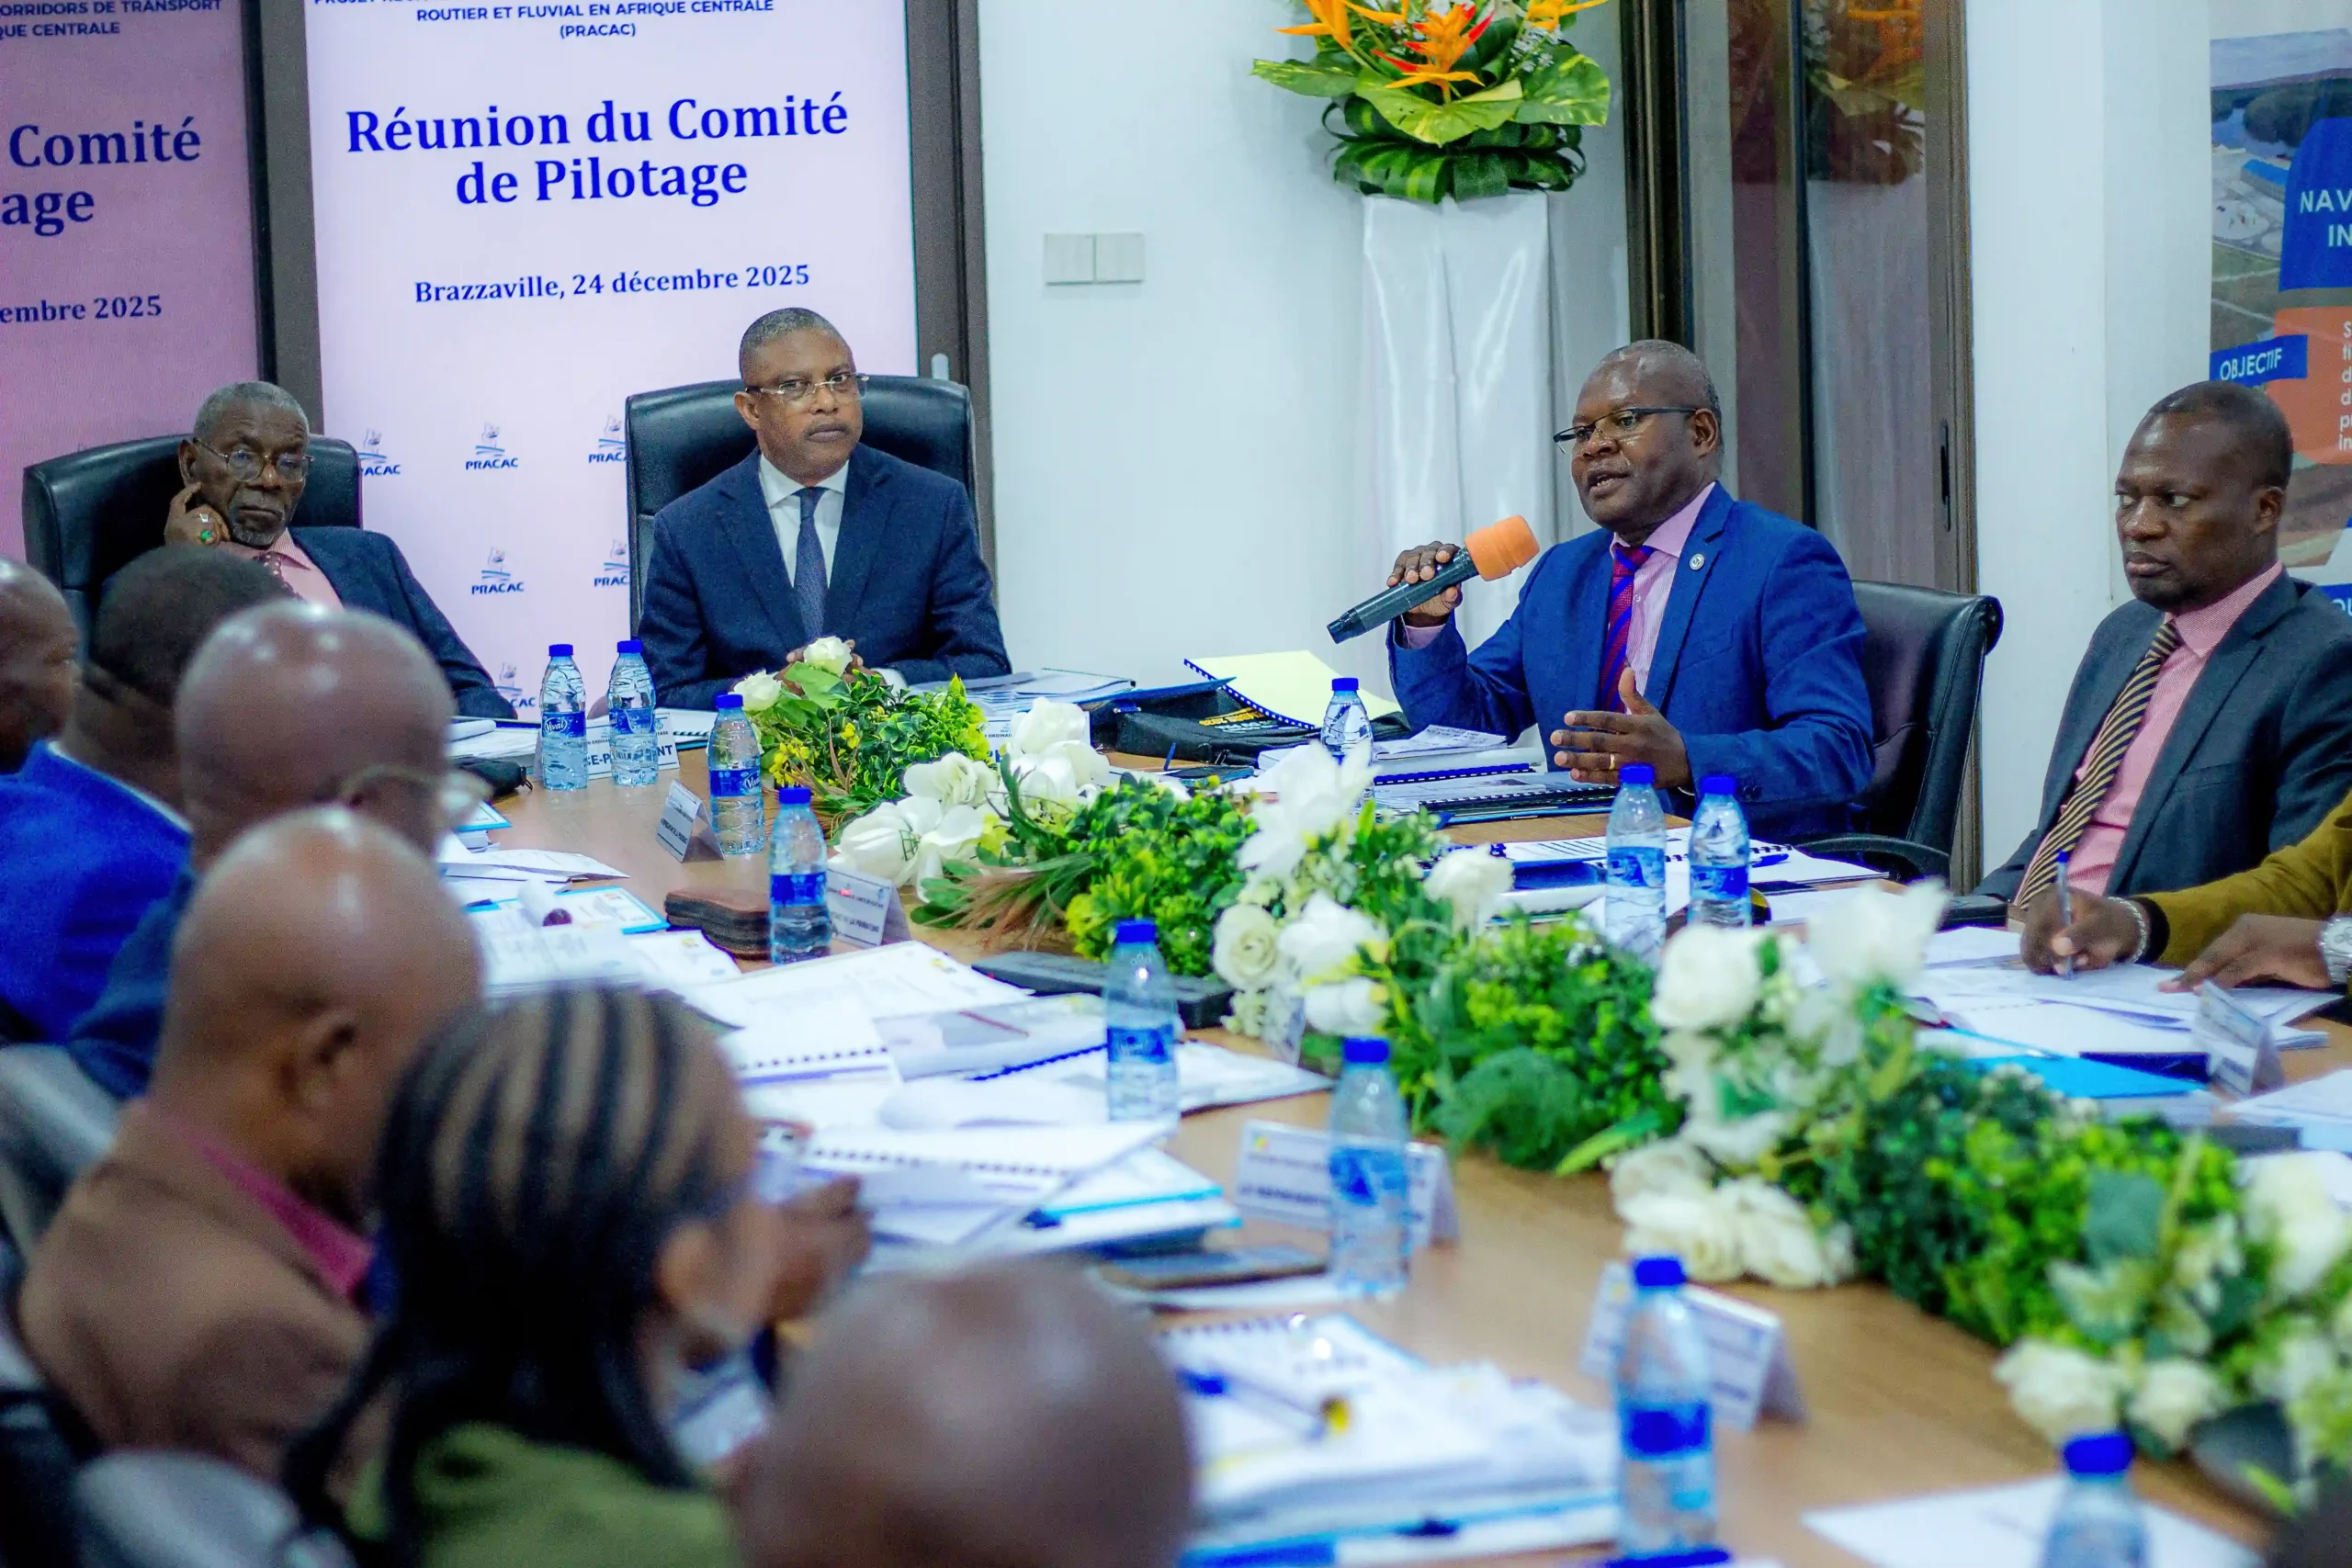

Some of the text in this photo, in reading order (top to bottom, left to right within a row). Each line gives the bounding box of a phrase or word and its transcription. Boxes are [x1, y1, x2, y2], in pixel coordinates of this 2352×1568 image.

[94, 1, 115, 14] DE
[121, 0, 221, 12] TRANSPORT
[417, 0, 774, 21] ROUTIER ET FLUVIAL EN AFRIQUE CENTRALE
[0, 22, 119, 40] UE CENTRALE
[560, 23, 636, 39] (PRACAC)
[345, 92, 848, 152] Réunion du Comité
[9, 117, 200, 167] Comité
[456, 156, 749, 208] de Pilotage
[2300, 189, 2352, 213] NAV
[2, 190, 95, 237] age
[414, 265, 809, 303] Brazzaville, 24 décembre 2025
[0, 295, 162, 323] embre 2025
[2220, 348, 2282, 381] OBJECTIF
[2339, 415, 2352, 433] p
[466, 457, 519, 471] PRACAC
[589, 452, 628, 464] PRAC
[359, 464, 401, 477] ACAC
[471, 582, 525, 595] PRACAC
[594, 575, 629, 588] PRAC
